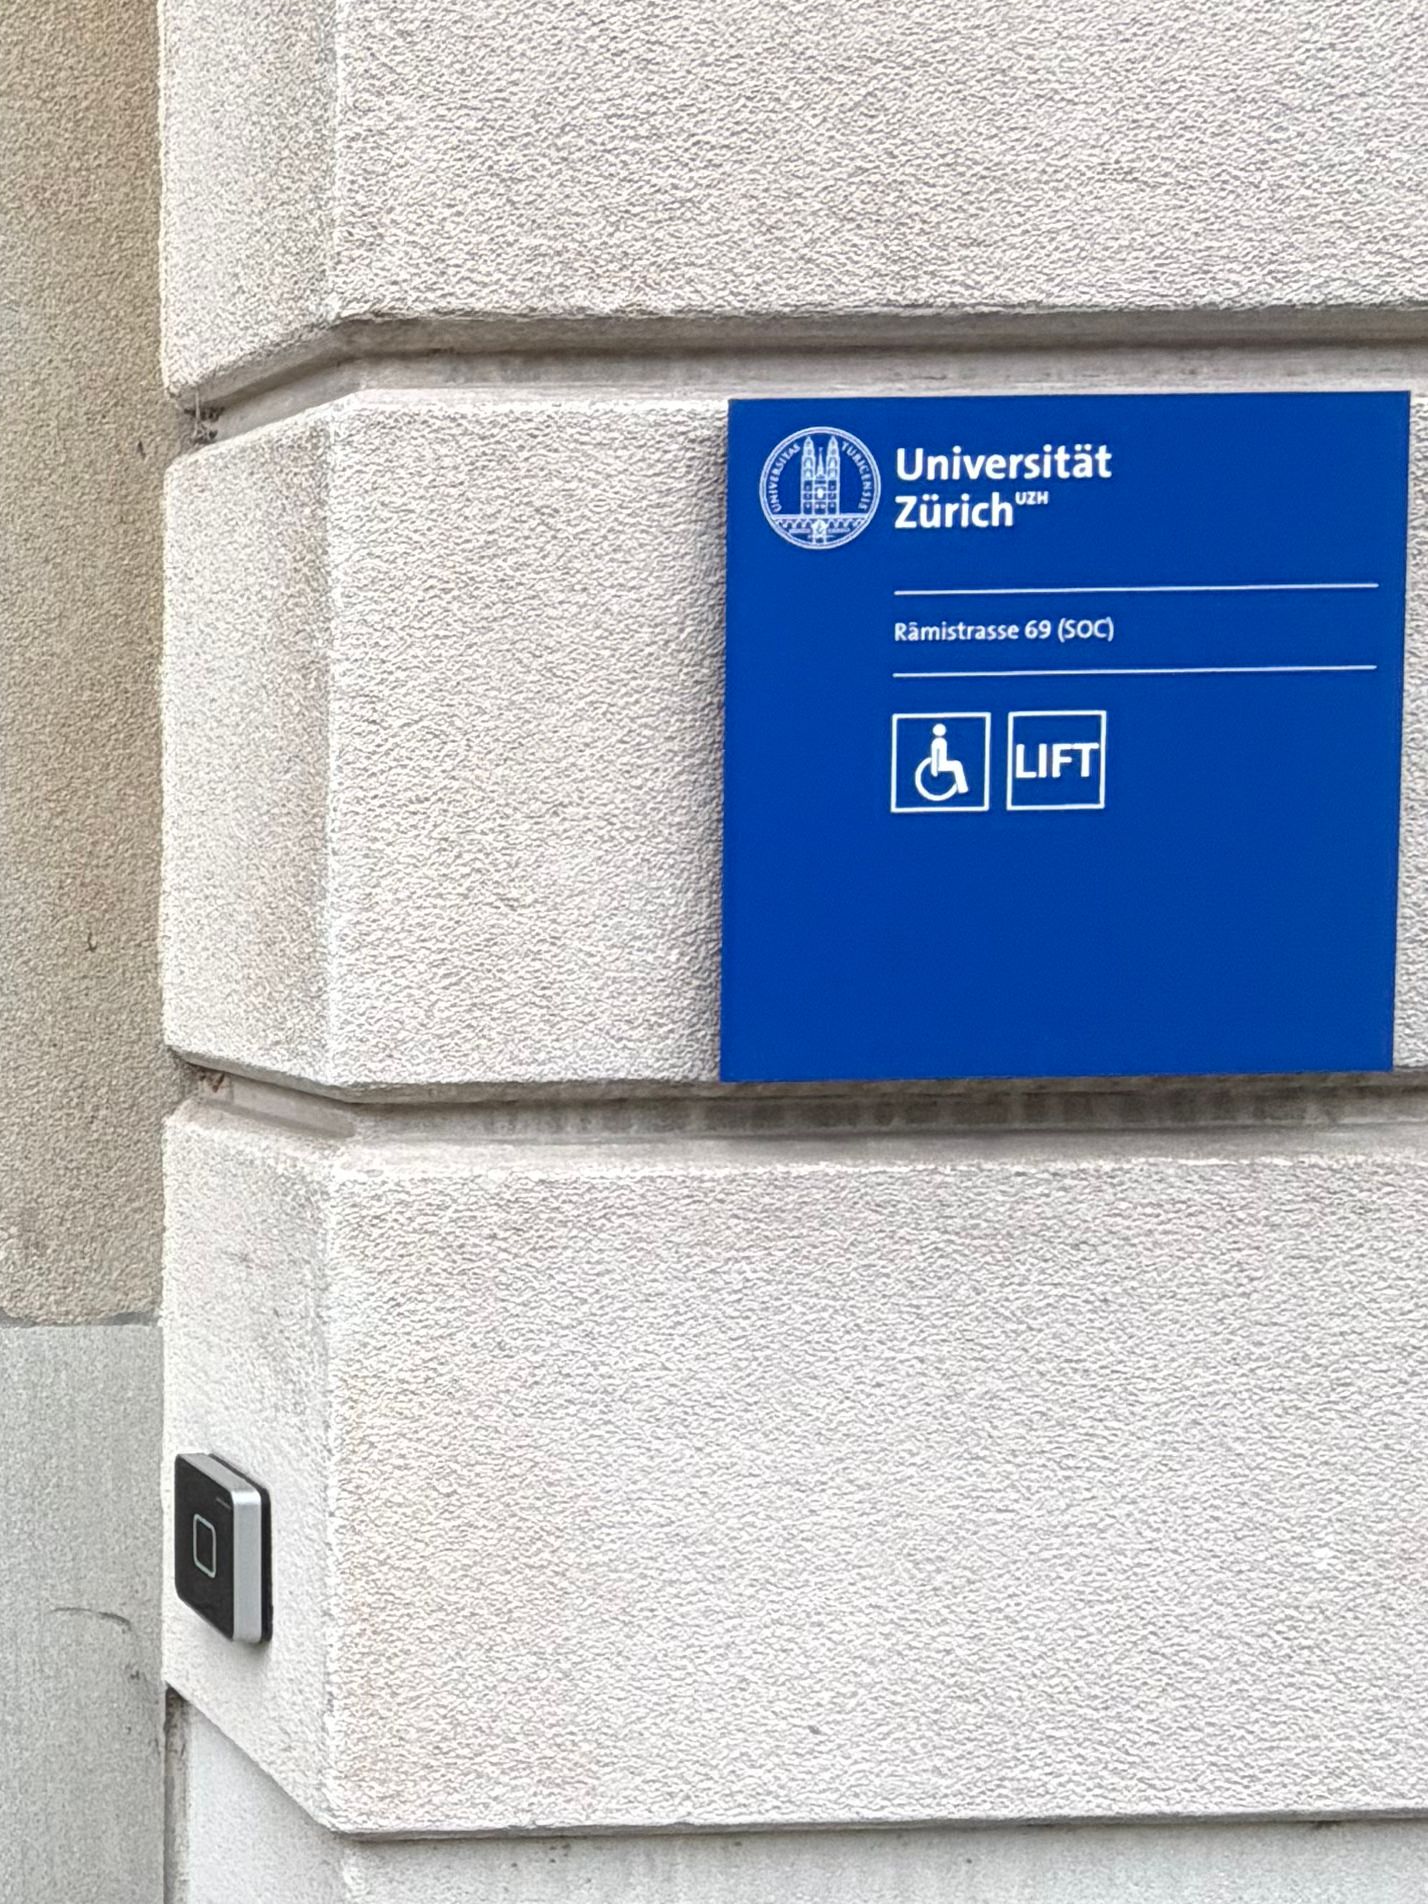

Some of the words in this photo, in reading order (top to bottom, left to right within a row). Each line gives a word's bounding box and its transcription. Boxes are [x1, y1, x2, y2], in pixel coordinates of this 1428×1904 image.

[895, 443, 1113, 482] Universität
[894, 491, 1014, 529] Zürich
[1015, 491, 1049, 506] UZH
[894, 620, 1020, 642] Rämistrasse
[1024, 619, 1052, 640] 69
[1057, 616, 1115, 644] (SOC)
[1015, 742, 1100, 779] LIFT
